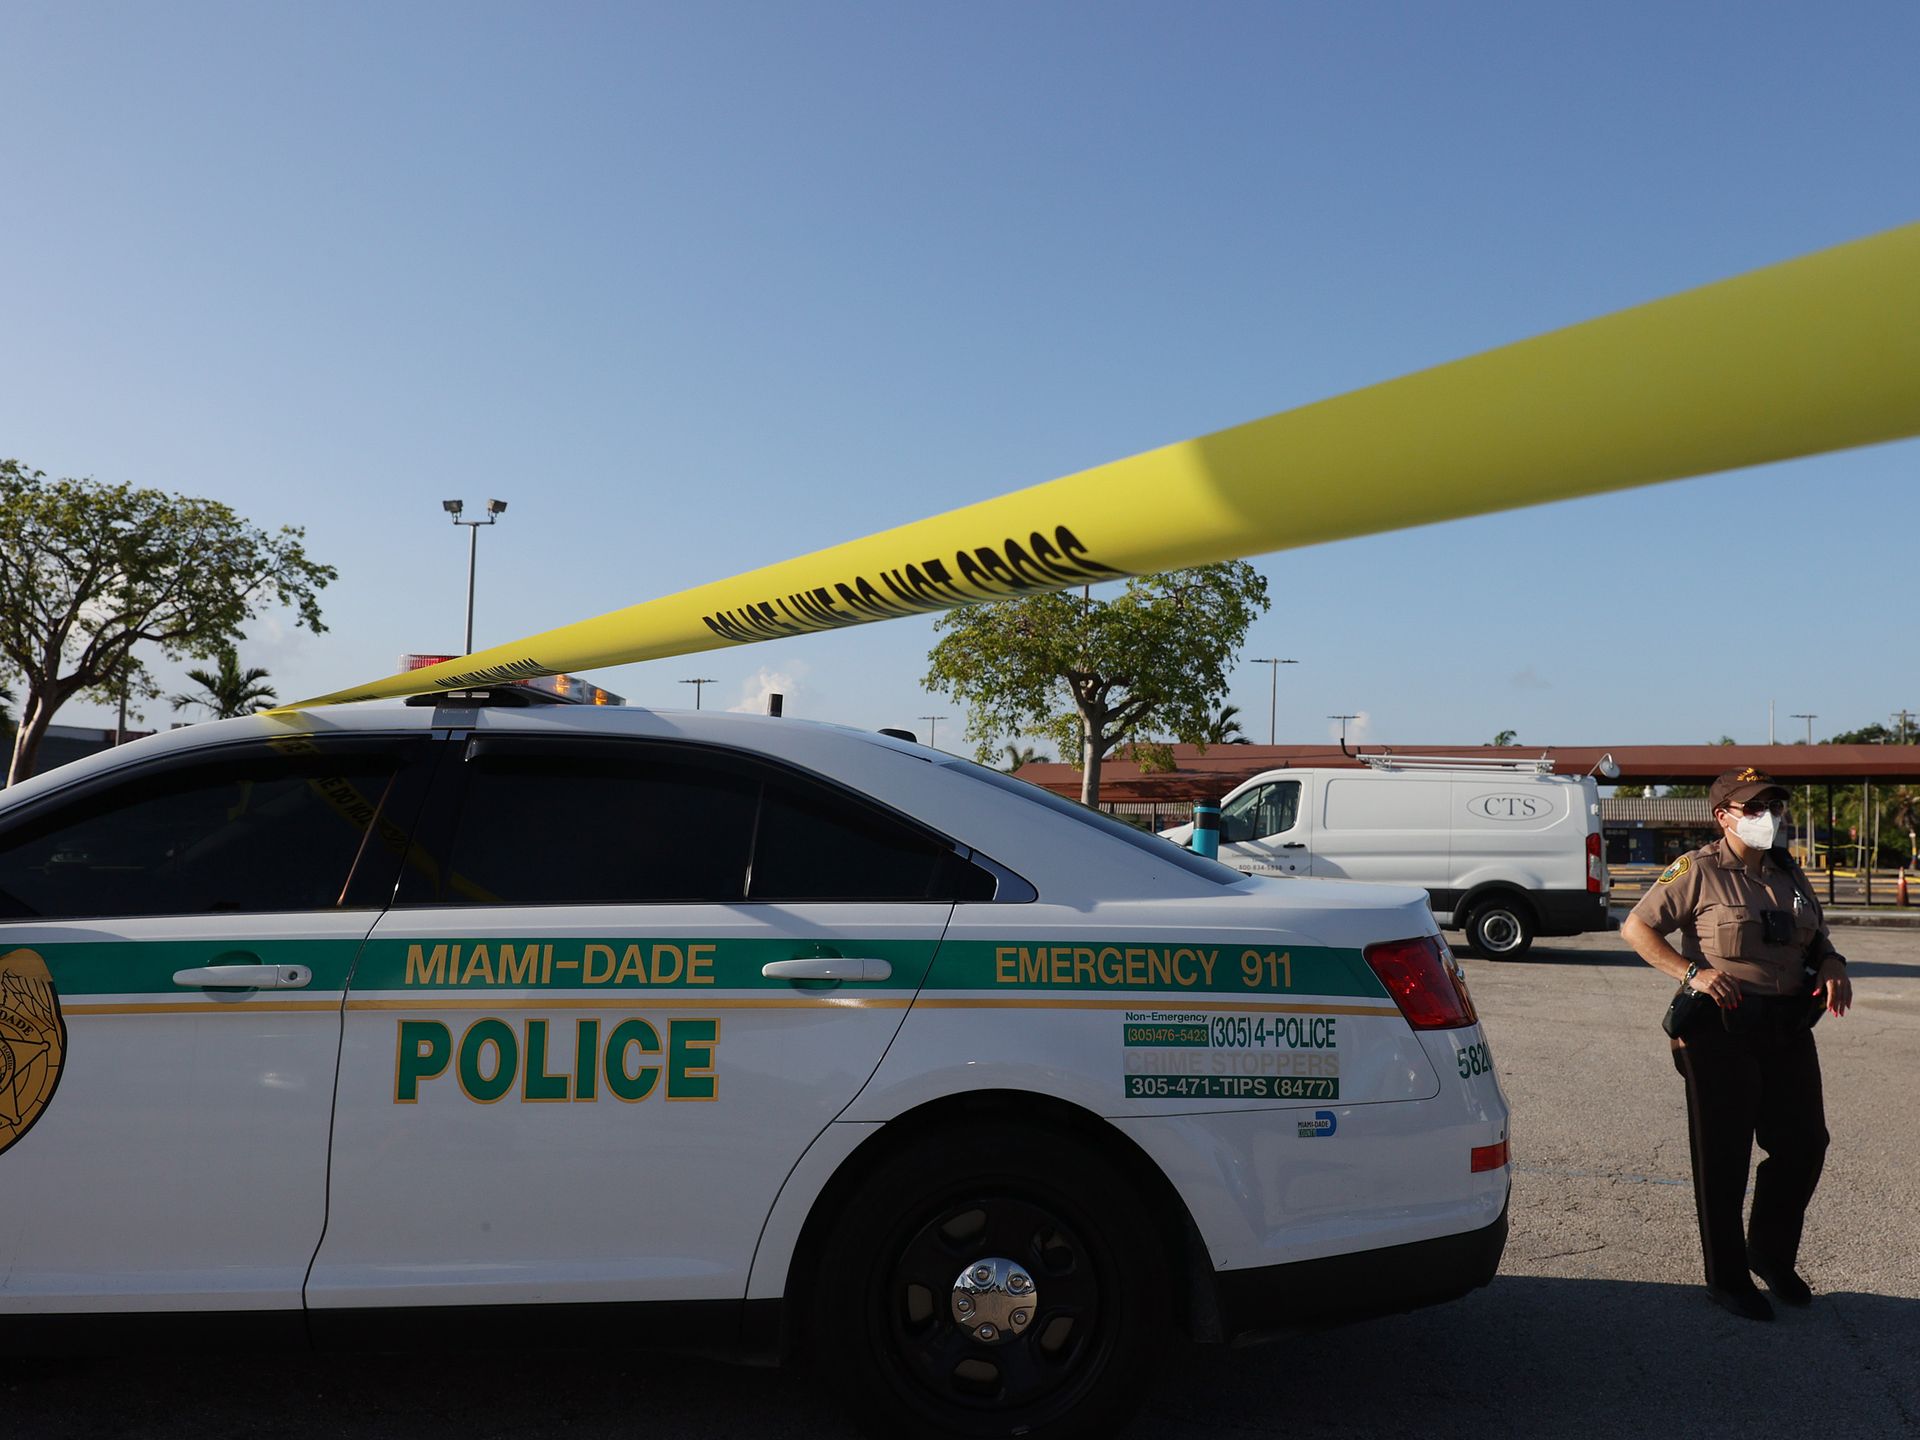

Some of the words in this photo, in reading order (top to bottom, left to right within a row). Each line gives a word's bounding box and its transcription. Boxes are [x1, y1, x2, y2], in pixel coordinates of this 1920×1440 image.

[1484, 797, 1536, 816] CTS
[405, 944, 716, 985] MIAMI-DADE
[996, 947, 1219, 986] EMERGENCY
[1241, 950, 1292, 987] 911
[1125, 1012, 1207, 1024] Non-Emergency
[1127, 1028, 1208, 1042] (305)476-5423
[393, 1016, 721, 1105] POLICE
[1126, 1051, 1200, 1075] CRIME
[1212, 1052, 1339, 1077] STOPPERS
[1131, 1077, 1267, 1096] 305-471-TIPS
[1274, 1079, 1334, 1097] (8477)
